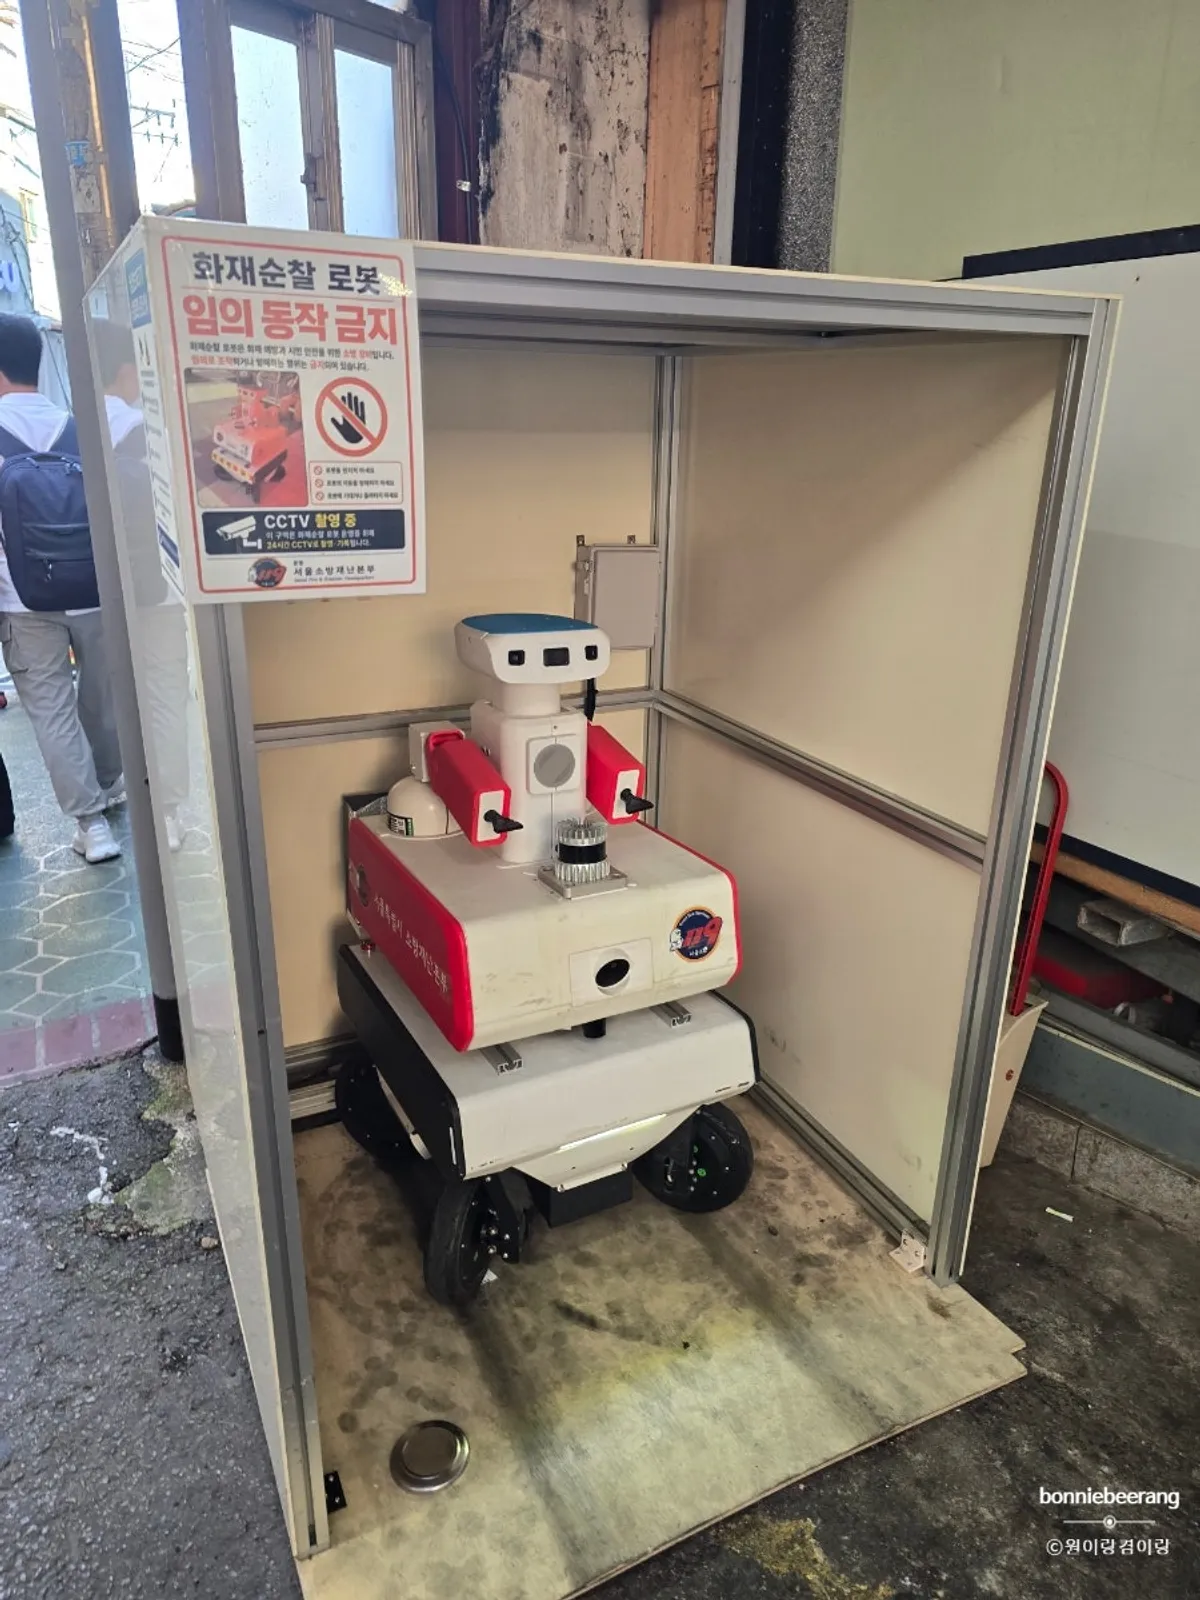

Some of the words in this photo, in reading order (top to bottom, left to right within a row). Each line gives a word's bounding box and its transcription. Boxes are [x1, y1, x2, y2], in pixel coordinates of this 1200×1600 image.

[192, 251, 316, 290] 화재순찰
[327, 263, 381, 295] 로봇
[182, 294, 254, 338] 임의
[261, 299, 329, 342] 동작
[335, 304, 398, 345] 금지
[264, 514, 310, 529] CCTV
[315, 512, 340, 528] 촬영
[344, 513, 357, 528] 중
